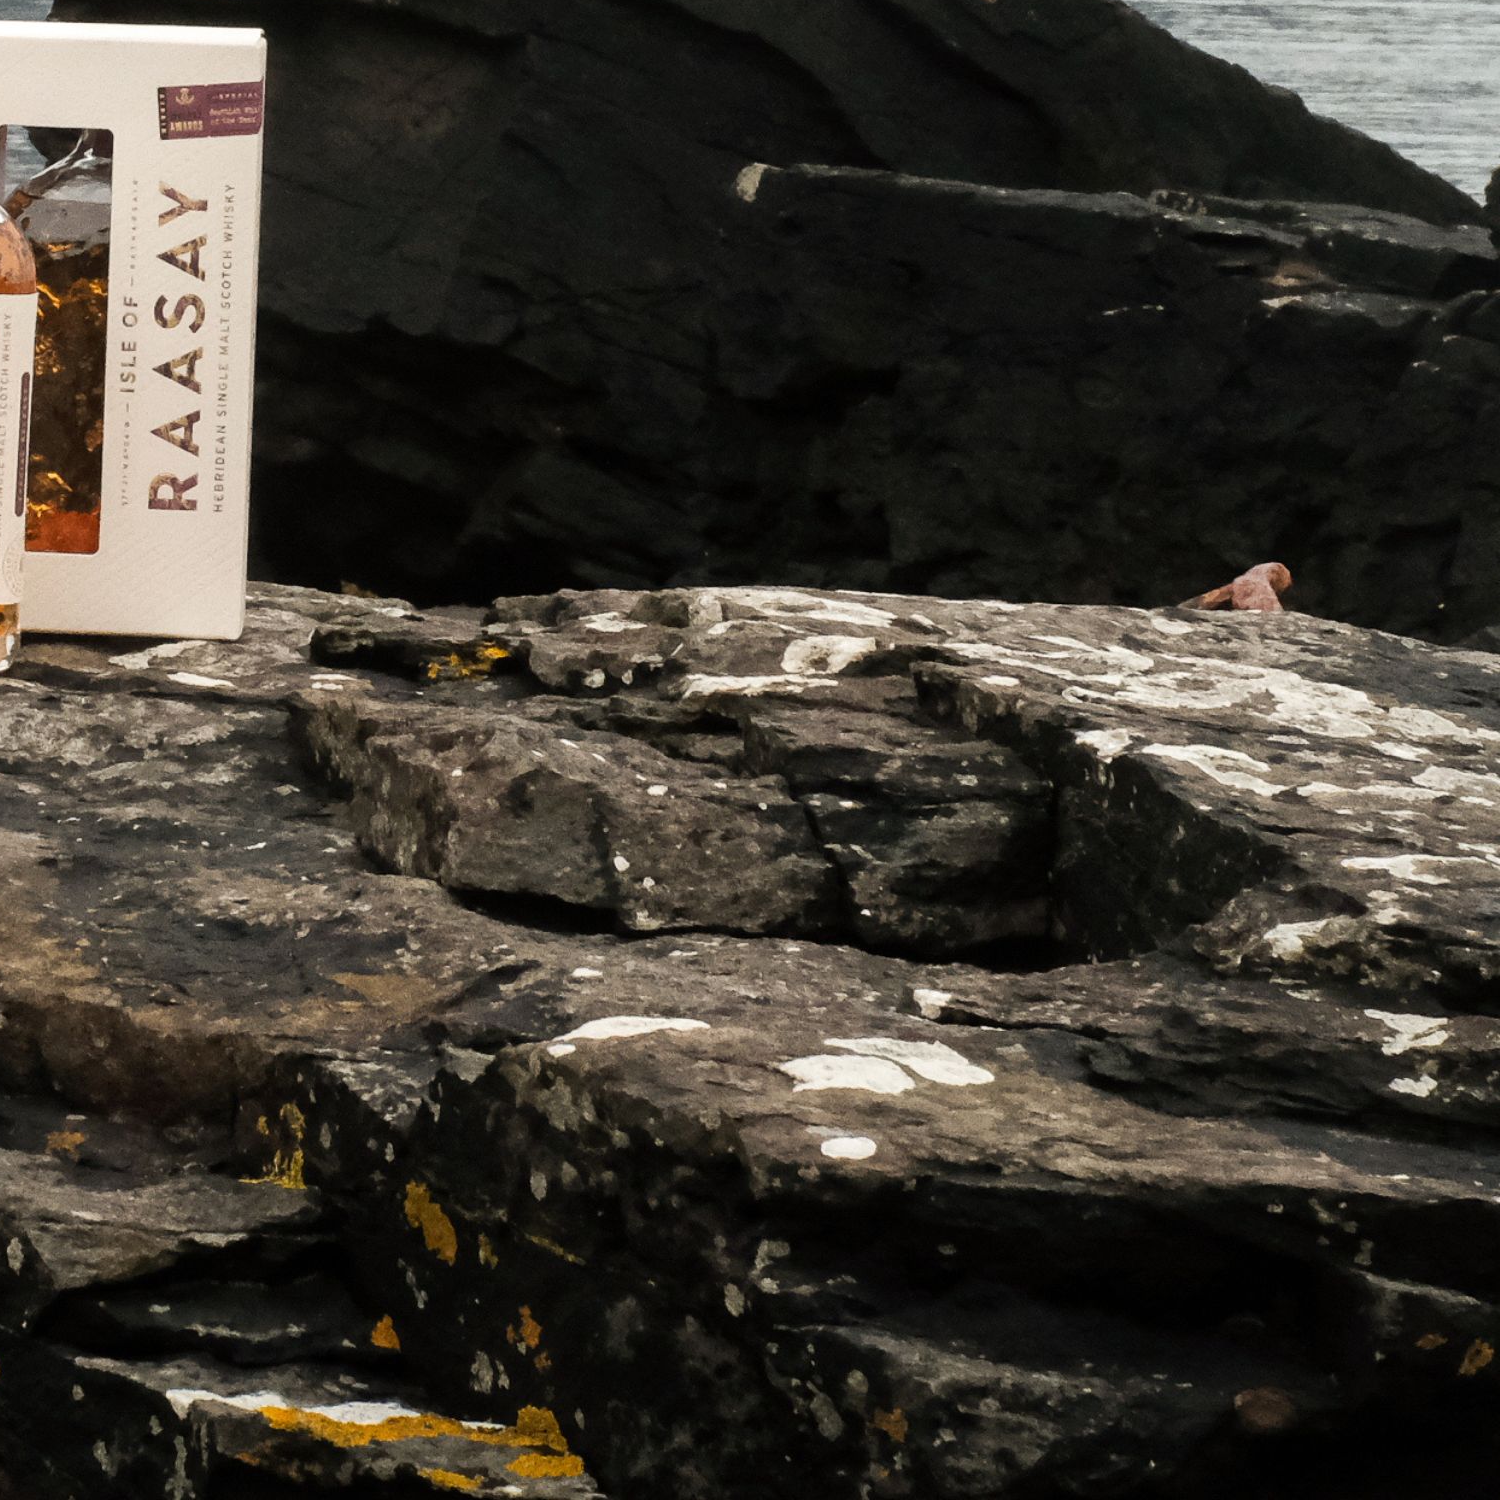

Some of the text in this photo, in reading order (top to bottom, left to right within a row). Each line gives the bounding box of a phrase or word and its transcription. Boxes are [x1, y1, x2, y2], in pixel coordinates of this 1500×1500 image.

[1, 313, 13, 362] WHISKY
[121, 296, 138, 328] OF
[119, 341, 137, 394] ISLE
[147, 180, 208, 512] RAASAY
[213, 184, 236, 513] HEBRIDEAN SINGLE MALT SCOTCH WHISKY
